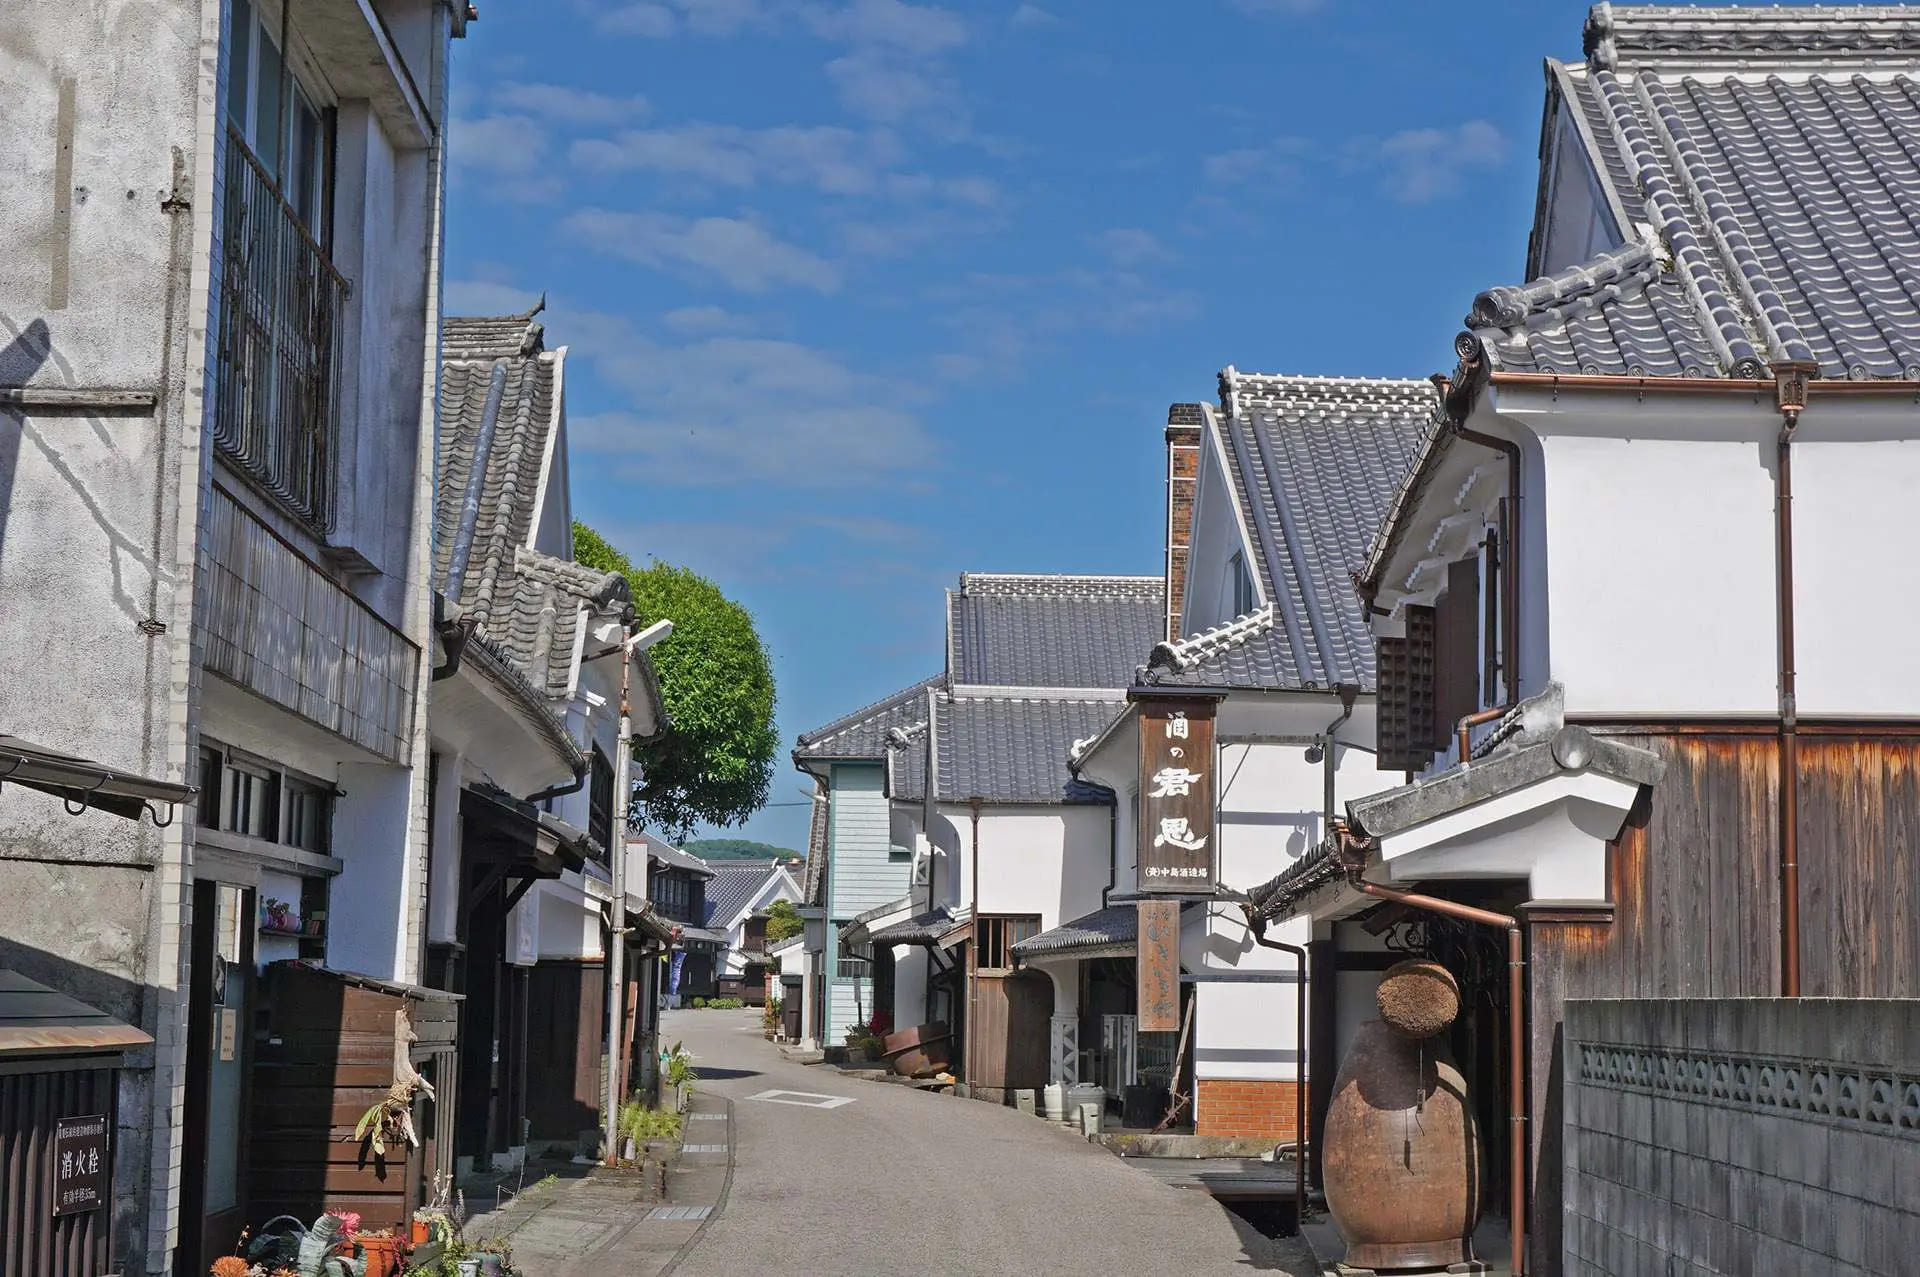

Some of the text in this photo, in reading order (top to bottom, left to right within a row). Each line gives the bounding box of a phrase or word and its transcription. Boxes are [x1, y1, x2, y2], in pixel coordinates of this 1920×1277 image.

[61, 1147, 98, 1179] 消火栓
[63, 1188, 96, 1204] 有効半径35m
